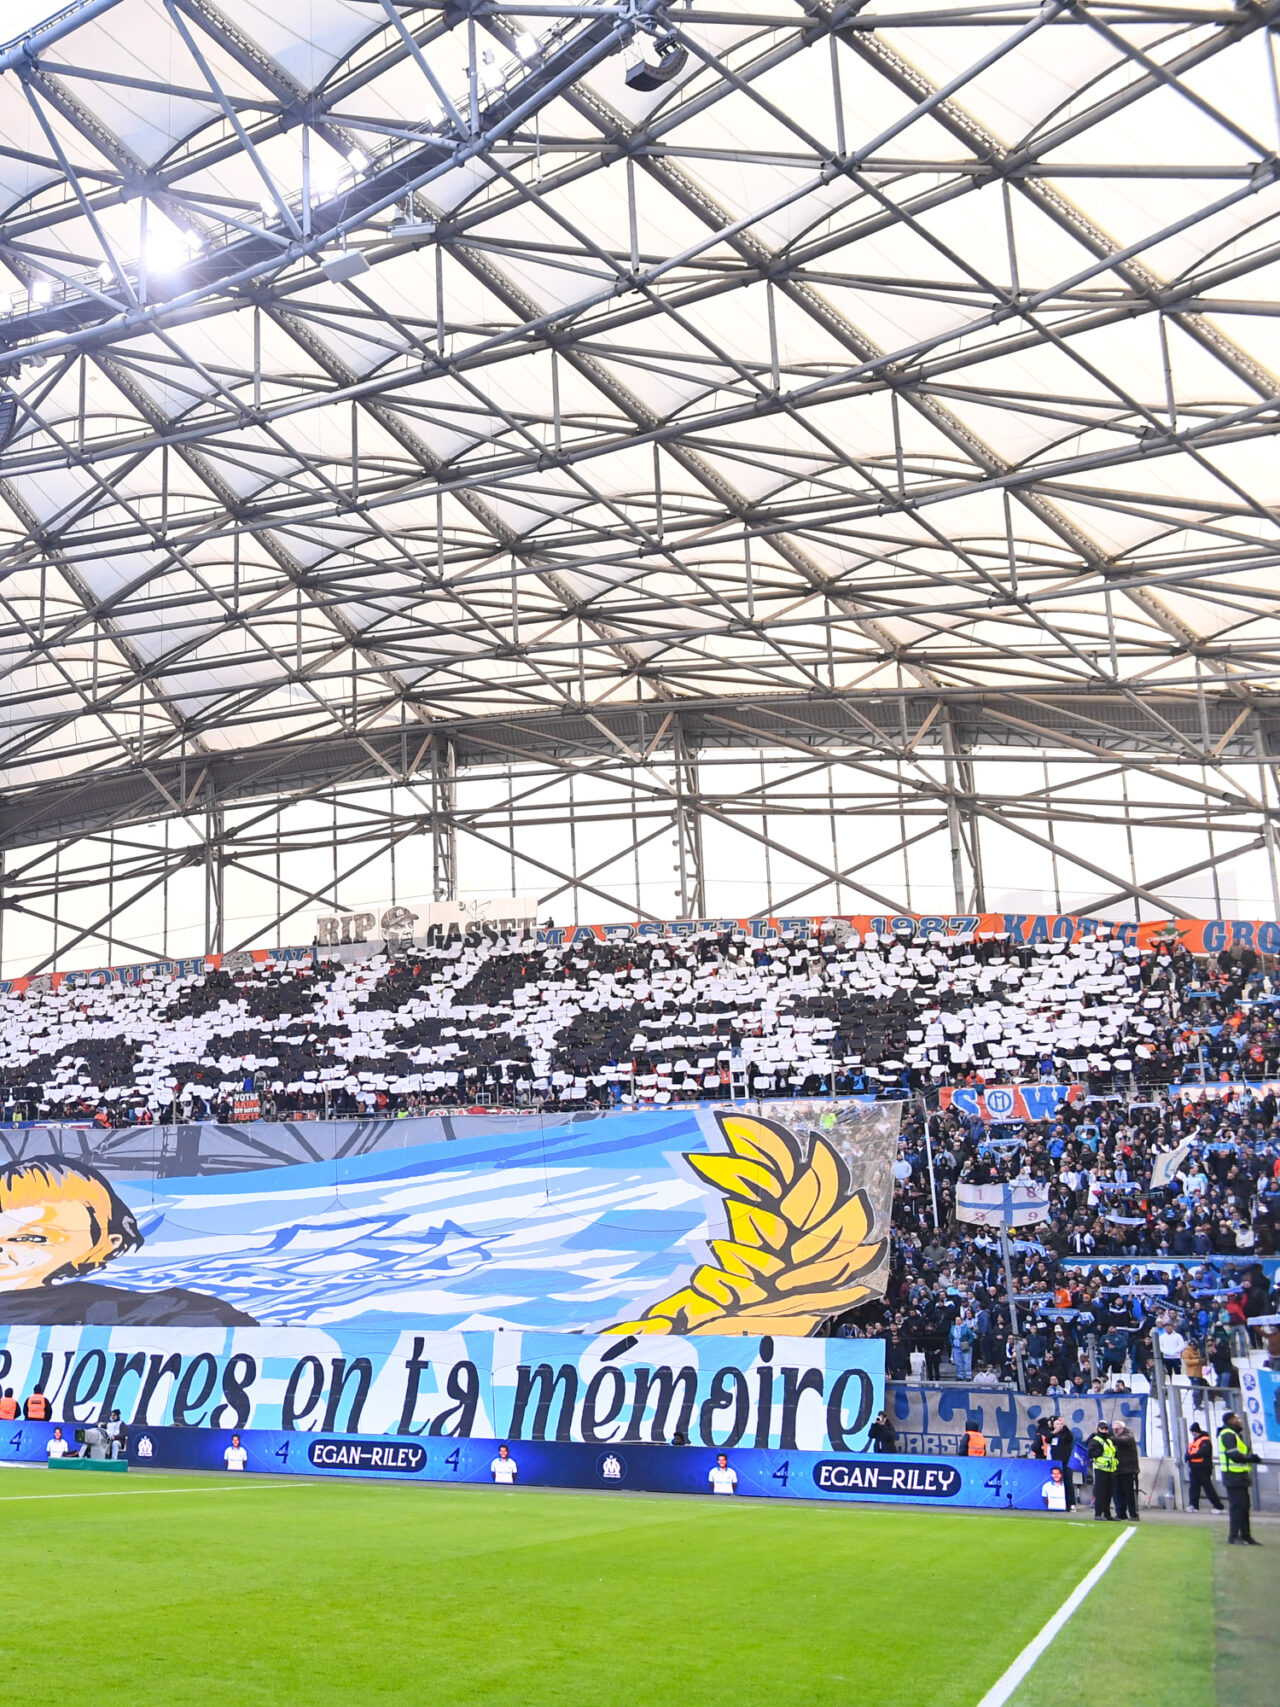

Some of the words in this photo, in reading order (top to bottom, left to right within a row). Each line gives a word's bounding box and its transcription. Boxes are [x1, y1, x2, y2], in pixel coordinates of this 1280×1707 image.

[317, 912, 376, 946] RIP
[427, 917, 537, 949] GASSET
[537, 918, 812, 946] MARSEILLE
[871, 915, 981, 939] 1987
[1004, 914, 1139, 947] KAOTIC
[38, 1348, 257, 1429] verres
[282, 1354, 373, 1434] en
[396, 1337, 479, 1437] ta
[508, 1335, 874, 1453] mémoire
[9, 1430, 23, 1451] 4
[275, 1440, 289, 1464] 4
[313, 1445, 422, 1467] EGAN-RILEY
[445, 1447, 460, 1471] 4
[772, 1460, 789, 1487] 4
[819, 1466, 955, 1491] EGAN-RILEY
[984, 1469, 1002, 1496] 4
